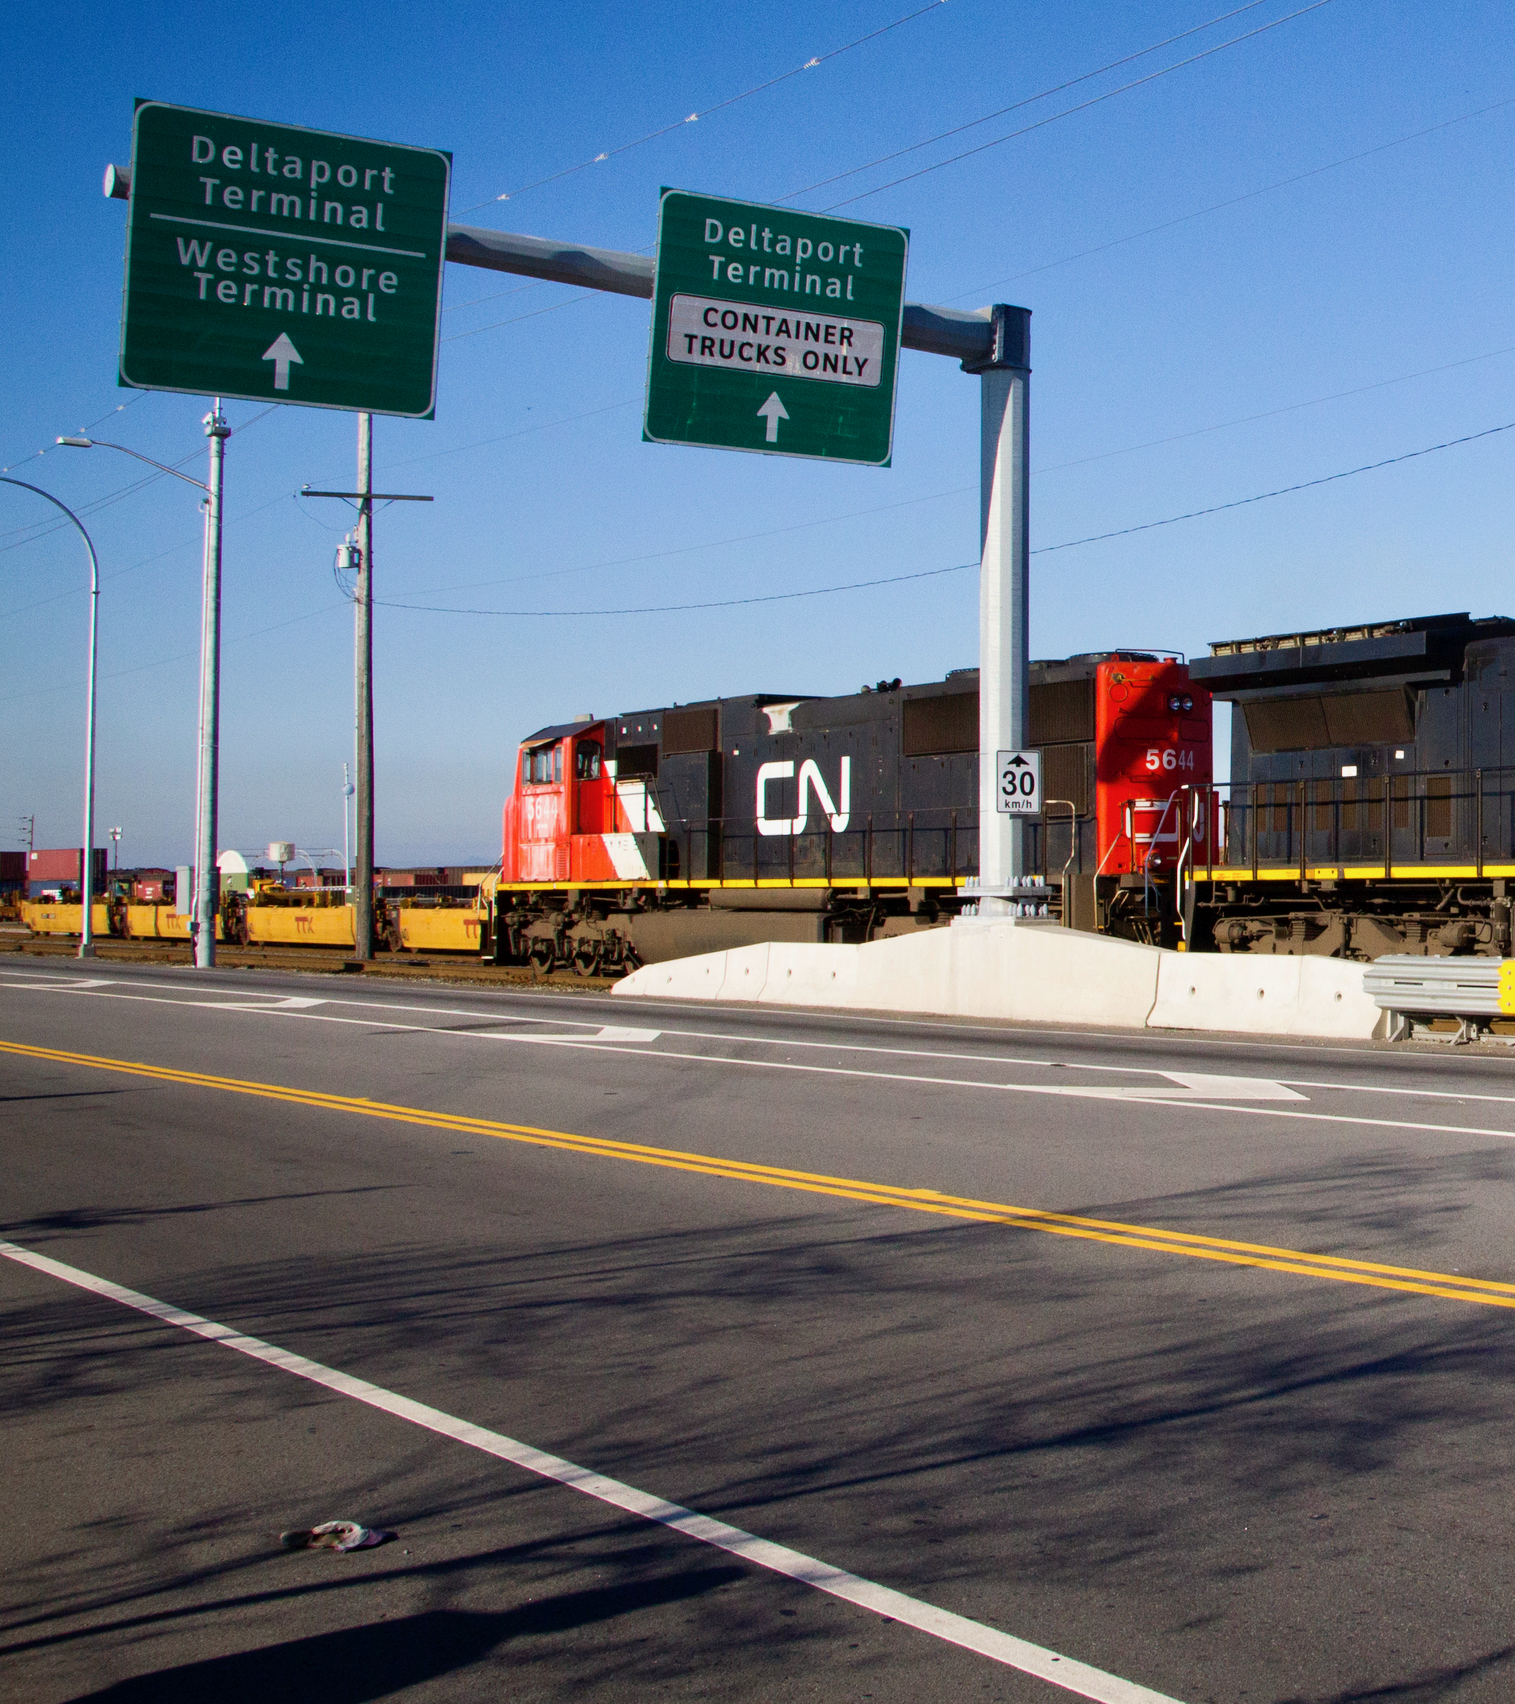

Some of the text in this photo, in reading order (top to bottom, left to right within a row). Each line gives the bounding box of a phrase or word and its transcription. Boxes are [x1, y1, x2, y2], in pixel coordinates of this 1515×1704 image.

[191, 135, 395, 195] Deltaport
[199, 176, 386, 232] Terminal
[176, 236, 399, 294] Westshore
[704, 218, 864, 268] Deltaport
[193, 271, 377, 322] Terminal
[708, 255, 855, 301] Terminal
[702, 306, 855, 348] CONTAINER
[683, 333, 870, 377] TRUCKS ONLY
[1145, 748, 1194, 771] 5644
[755, 755, 851, 836] CN
[1002, 770, 1035, 796] 30
[1004, 799, 1032, 809] km/h
[527, 796, 558, 820] 5644
